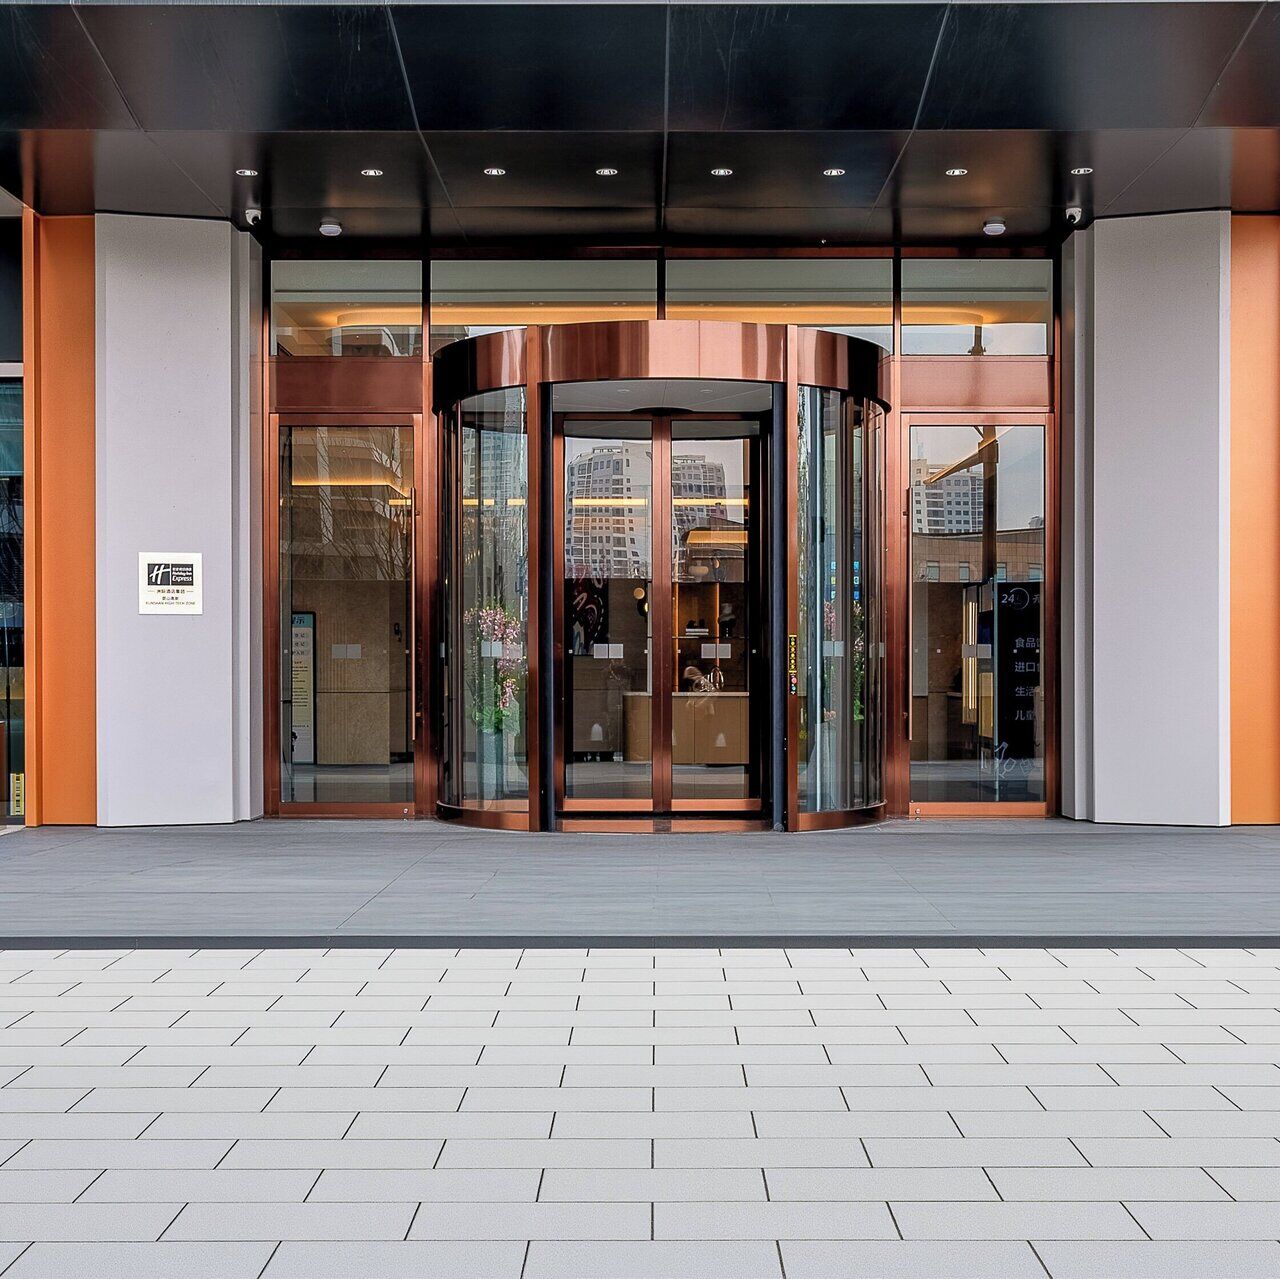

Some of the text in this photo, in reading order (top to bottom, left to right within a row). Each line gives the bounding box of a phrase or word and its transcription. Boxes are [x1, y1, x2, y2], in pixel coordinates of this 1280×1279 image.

[1001, 594, 1015, 604] 24
[1014, 637, 1040, 648] 食品
[1014, 661, 1040, 672] 进口
